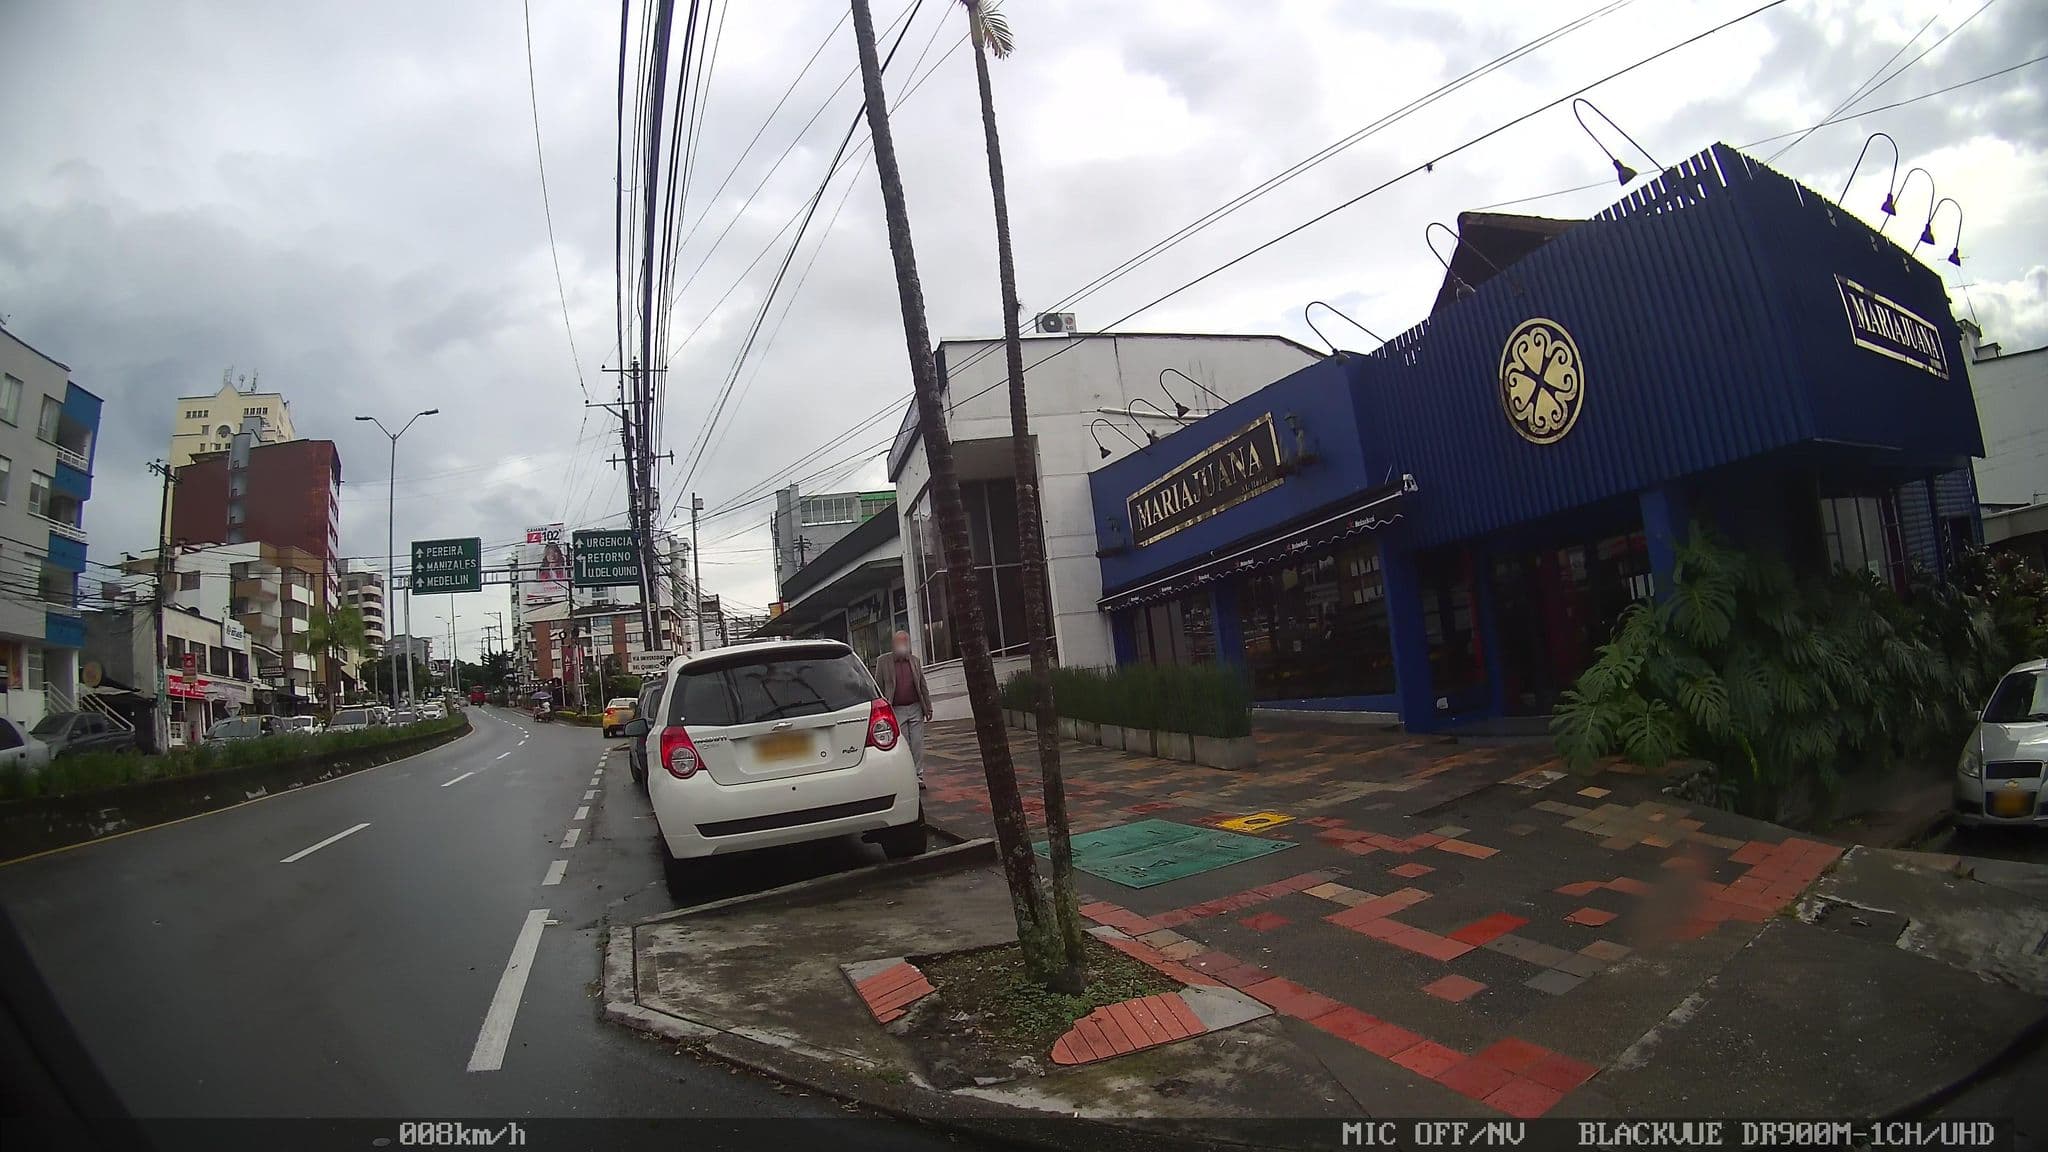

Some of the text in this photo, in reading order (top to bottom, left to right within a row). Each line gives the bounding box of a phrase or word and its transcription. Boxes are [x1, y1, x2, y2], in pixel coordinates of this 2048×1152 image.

[1849, 293, 1940, 359] MARIAJUANA
[1136, 440, 1263, 531] MARIAJUANA
[586, 536, 633, 548] URGENCIA
[426, 545, 464, 557] PEREIRA
[587, 551, 631, 563] RETORNO
[426, 559, 477, 572] MANIZALES
[427, 574, 469, 588] MEDELLIN
